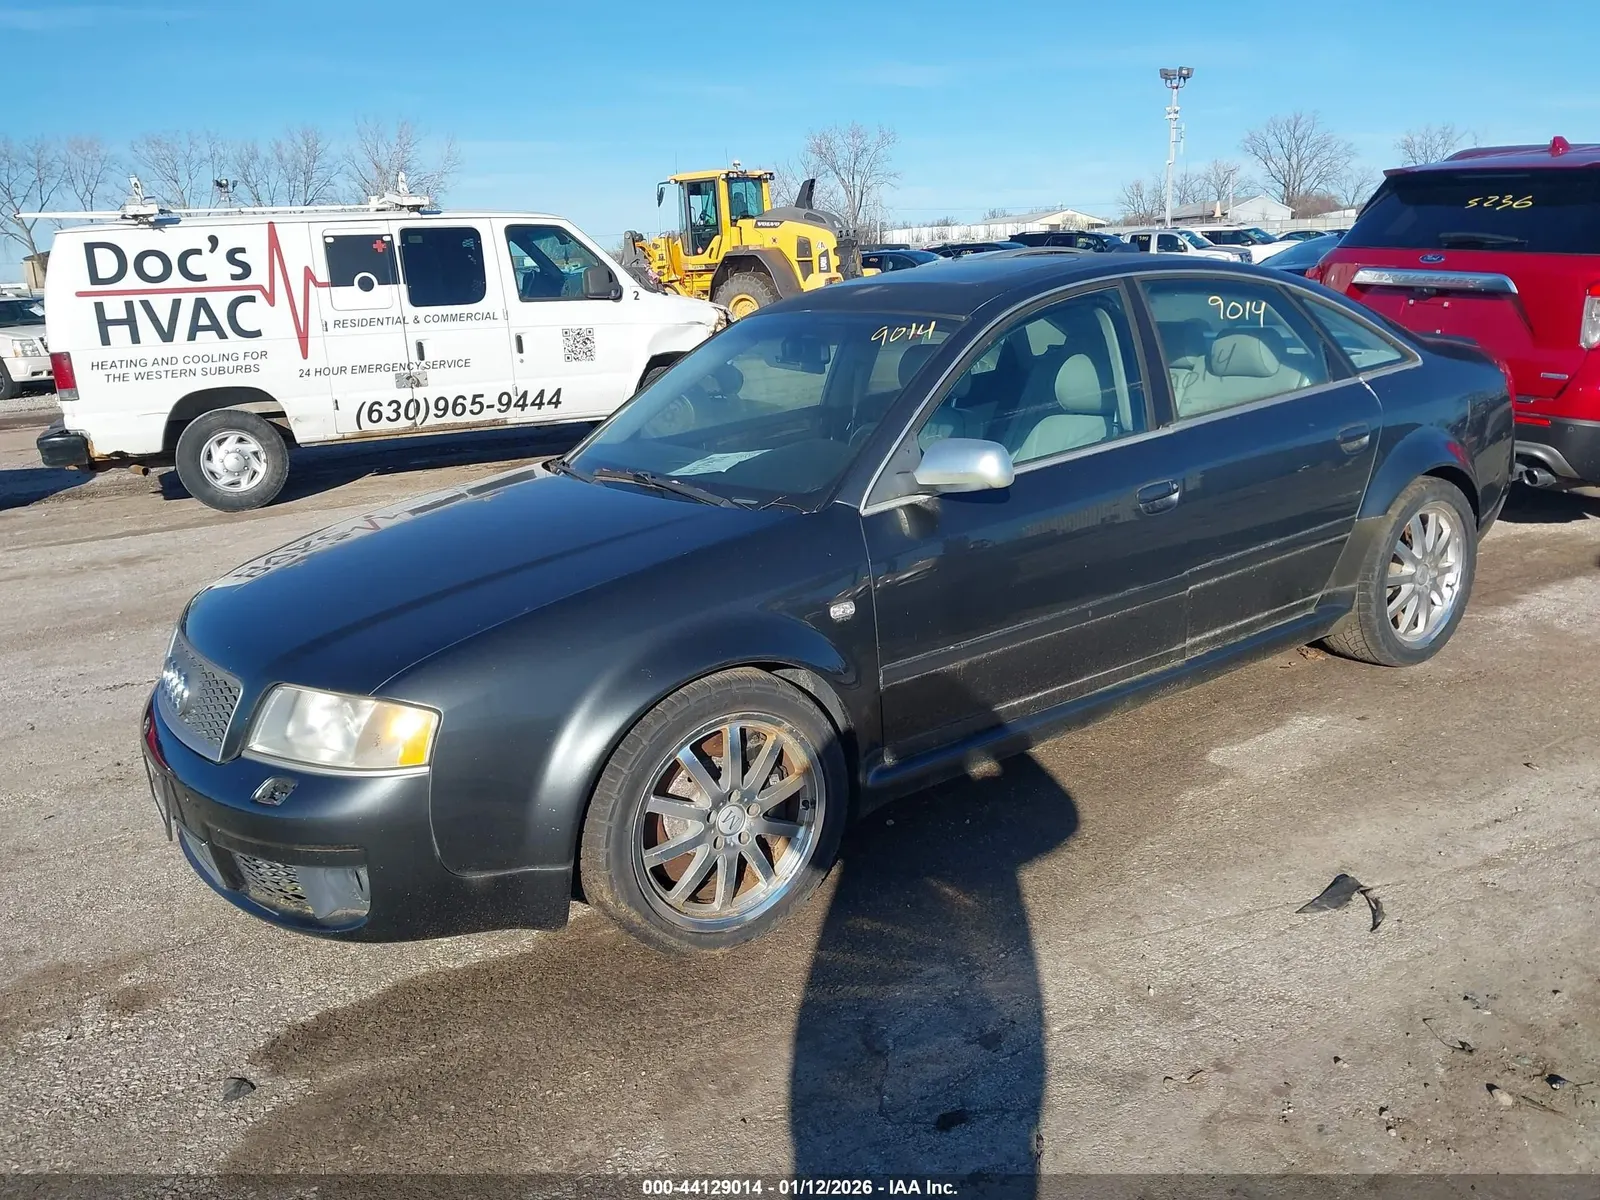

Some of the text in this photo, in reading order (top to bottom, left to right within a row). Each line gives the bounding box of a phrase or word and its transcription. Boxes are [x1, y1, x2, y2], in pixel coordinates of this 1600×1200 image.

[1464, 194, 1533, 211] 5236
[83, 234, 252, 286] Doc's
[632, 290, 641, 301] 2
[93, 294, 263, 346] HVAC
[332, 311, 499, 329] RESIDENTIAL & COMMERCIAL
[1207, 295, 1266, 328] 9014
[870, 320, 936, 346] 9014
[90, 350, 268, 371] HEATING AND COOLING FOR
[298, 358, 472, 378] 24 HOUR EMERGENCY SERVICE
[105, 363, 261, 383] THE WESTERN SUBURBS
[355, 387, 563, 431] (630)965-9444
